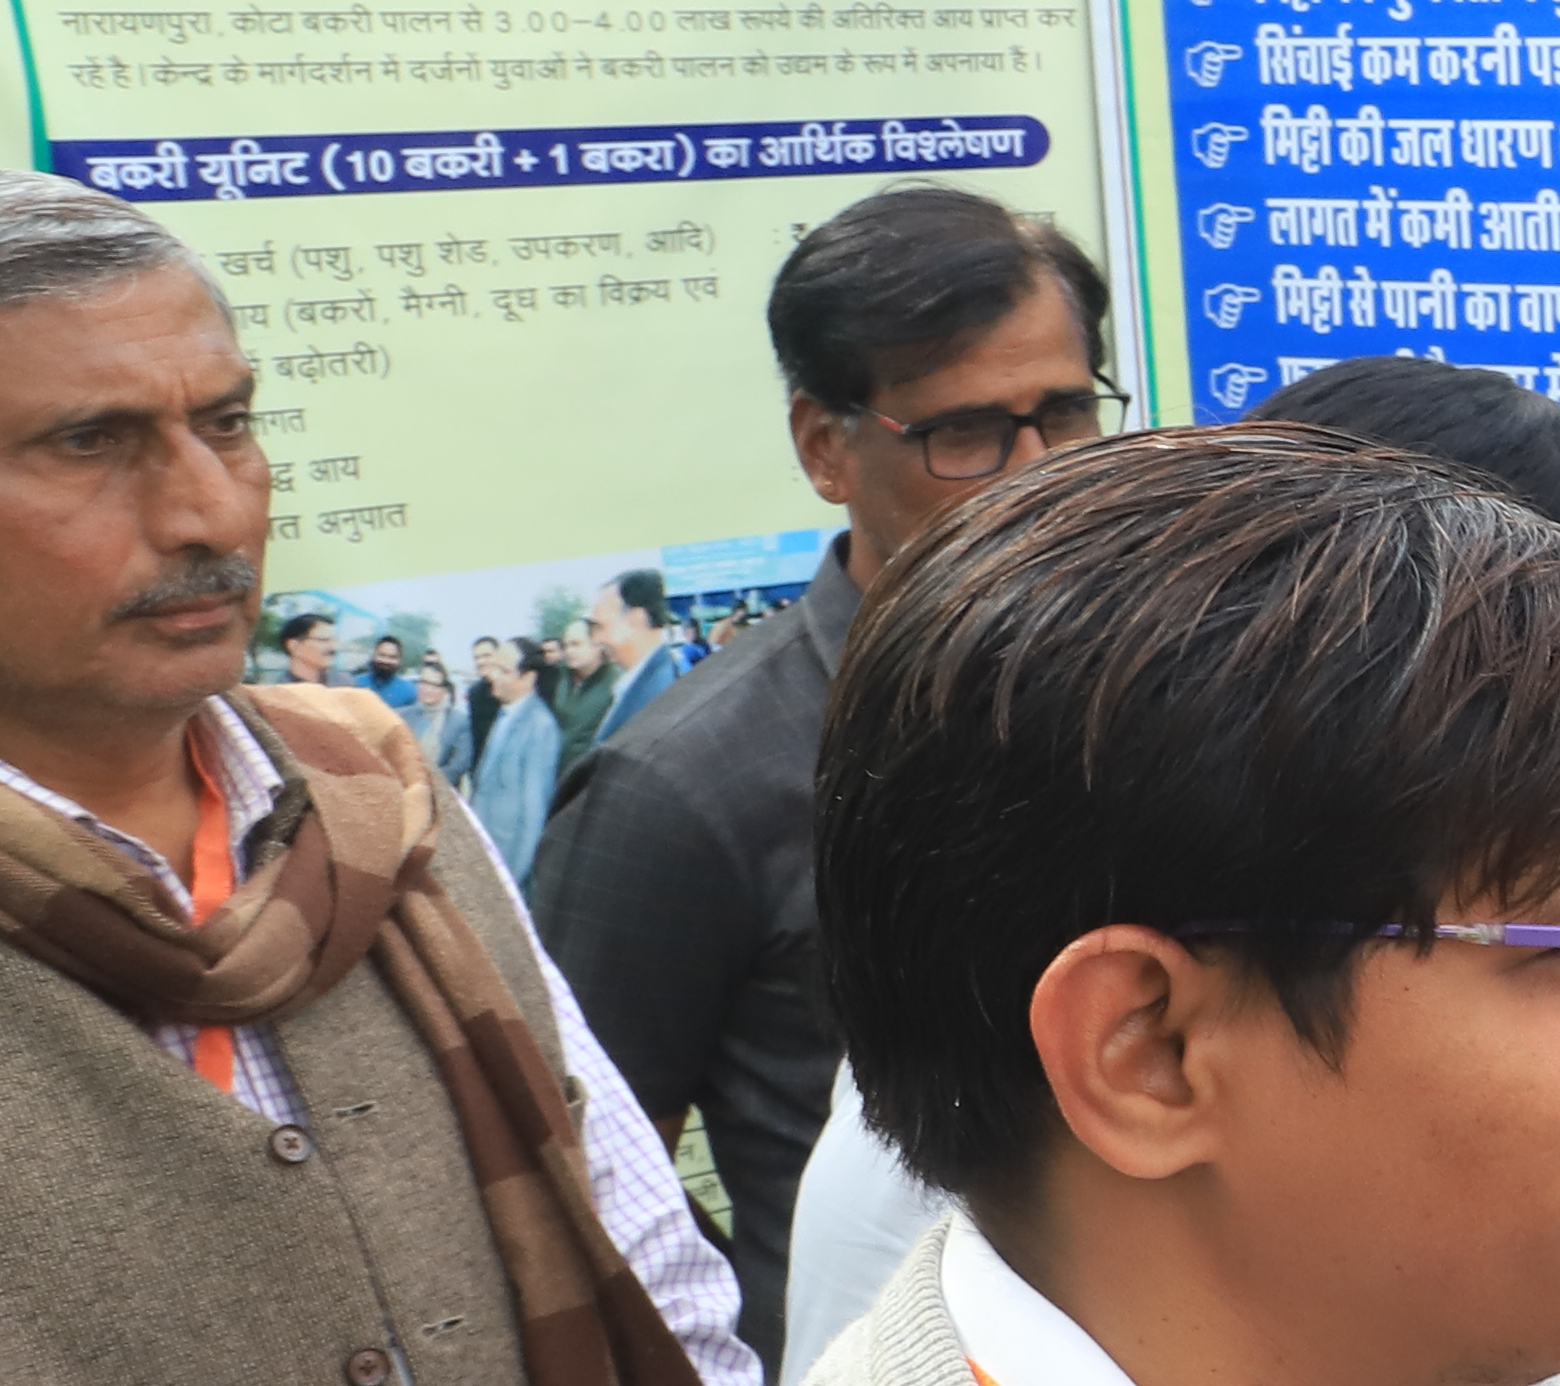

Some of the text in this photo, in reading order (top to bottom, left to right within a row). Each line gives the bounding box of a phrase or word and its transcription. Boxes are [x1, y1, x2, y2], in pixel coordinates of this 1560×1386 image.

[1254, 22, 1355, 92] सिंचाई
[1356, 36, 1422, 85] कम
[1423, 22, 1525, 86] करनी
[84, 119, 1032, 201] बकरी यूनिट (10 बकरी + 1 बकरा) का आर्थिक विश्लेषण
[1259, 103, 1334, 174] मिट्टी
[1334, 104, 1388, 167] की
[1387, 118, 1456, 168] जल
[1459, 119, 1555, 169] धारण
[1265, 197, 1362, 247] लागत
[1361, 185, 1399, 248] में
[1398, 187, 1474, 250] कमी
[1271, 263, 1346, 334] मिट्टी
[1345, 265, 1378, 327] से
[1379, 267, 1459, 330] पानी
[1459, 282, 1515, 332] का
[316, 501, 408, 544] अनुपात
